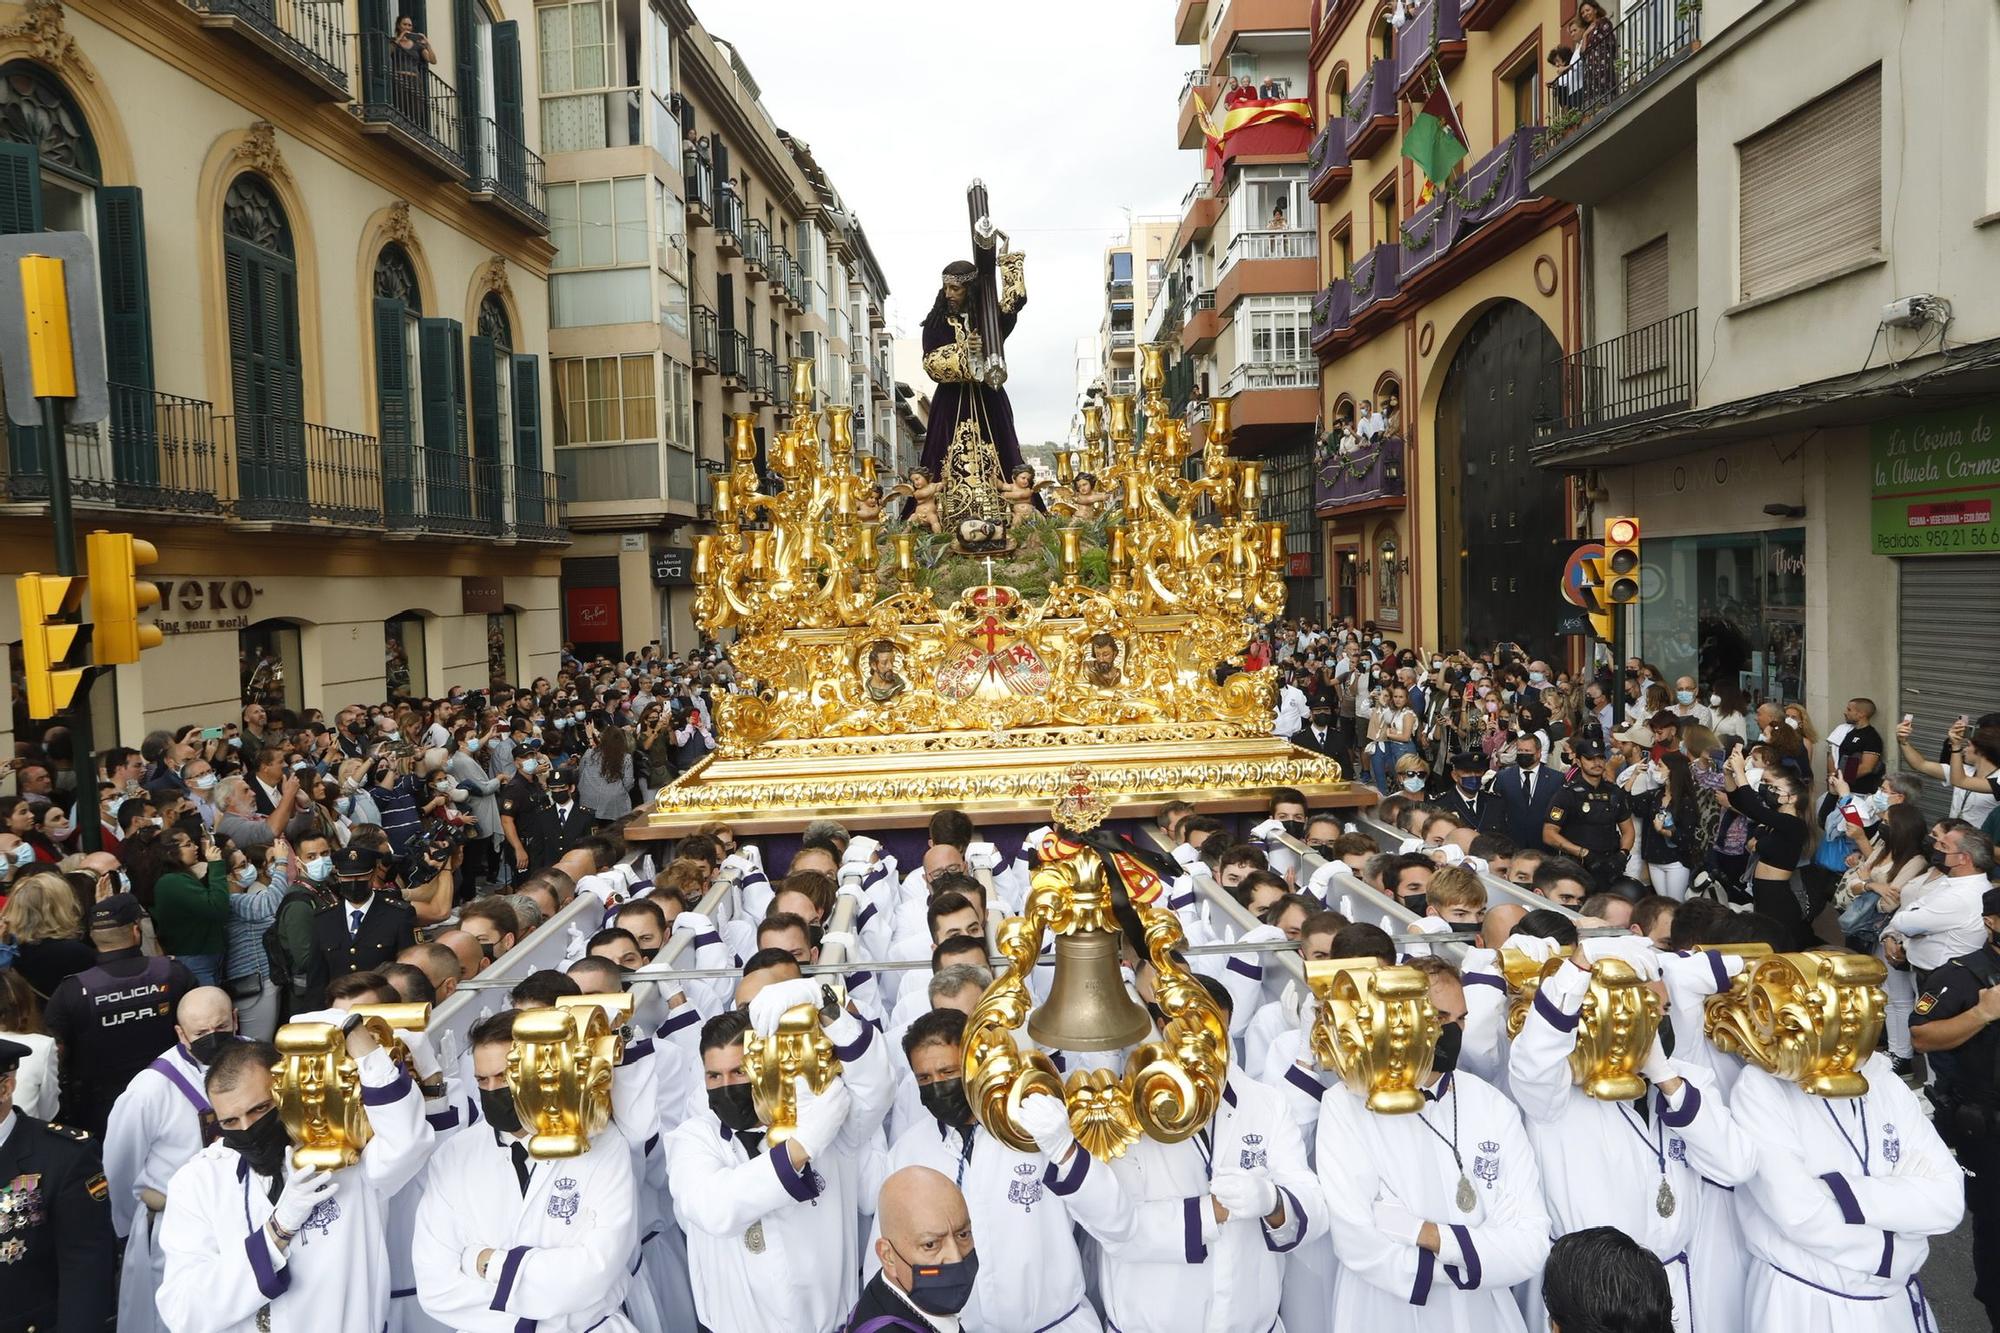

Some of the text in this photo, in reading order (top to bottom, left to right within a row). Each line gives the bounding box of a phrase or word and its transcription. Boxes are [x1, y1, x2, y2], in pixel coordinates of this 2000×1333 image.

[1887, 414, 1993, 457] La Cocina de
[1875, 462, 1887, 486] la
[1892, 455, 1941, 484] Abuela
[1878, 531, 1922, 548] Pedidos:
[1926, 529, 1949, 547] 952
[1952, 529, 1965, 546] 21
[1971, 528, 1987, 545] 56
[140, 580, 253, 611] YOKO
[185, 620, 212, 632] your
[217, 615, 249, 628] world
[95, 984, 159, 1006] POLICIA
[102, 1007, 157, 1027] U.P.R.
